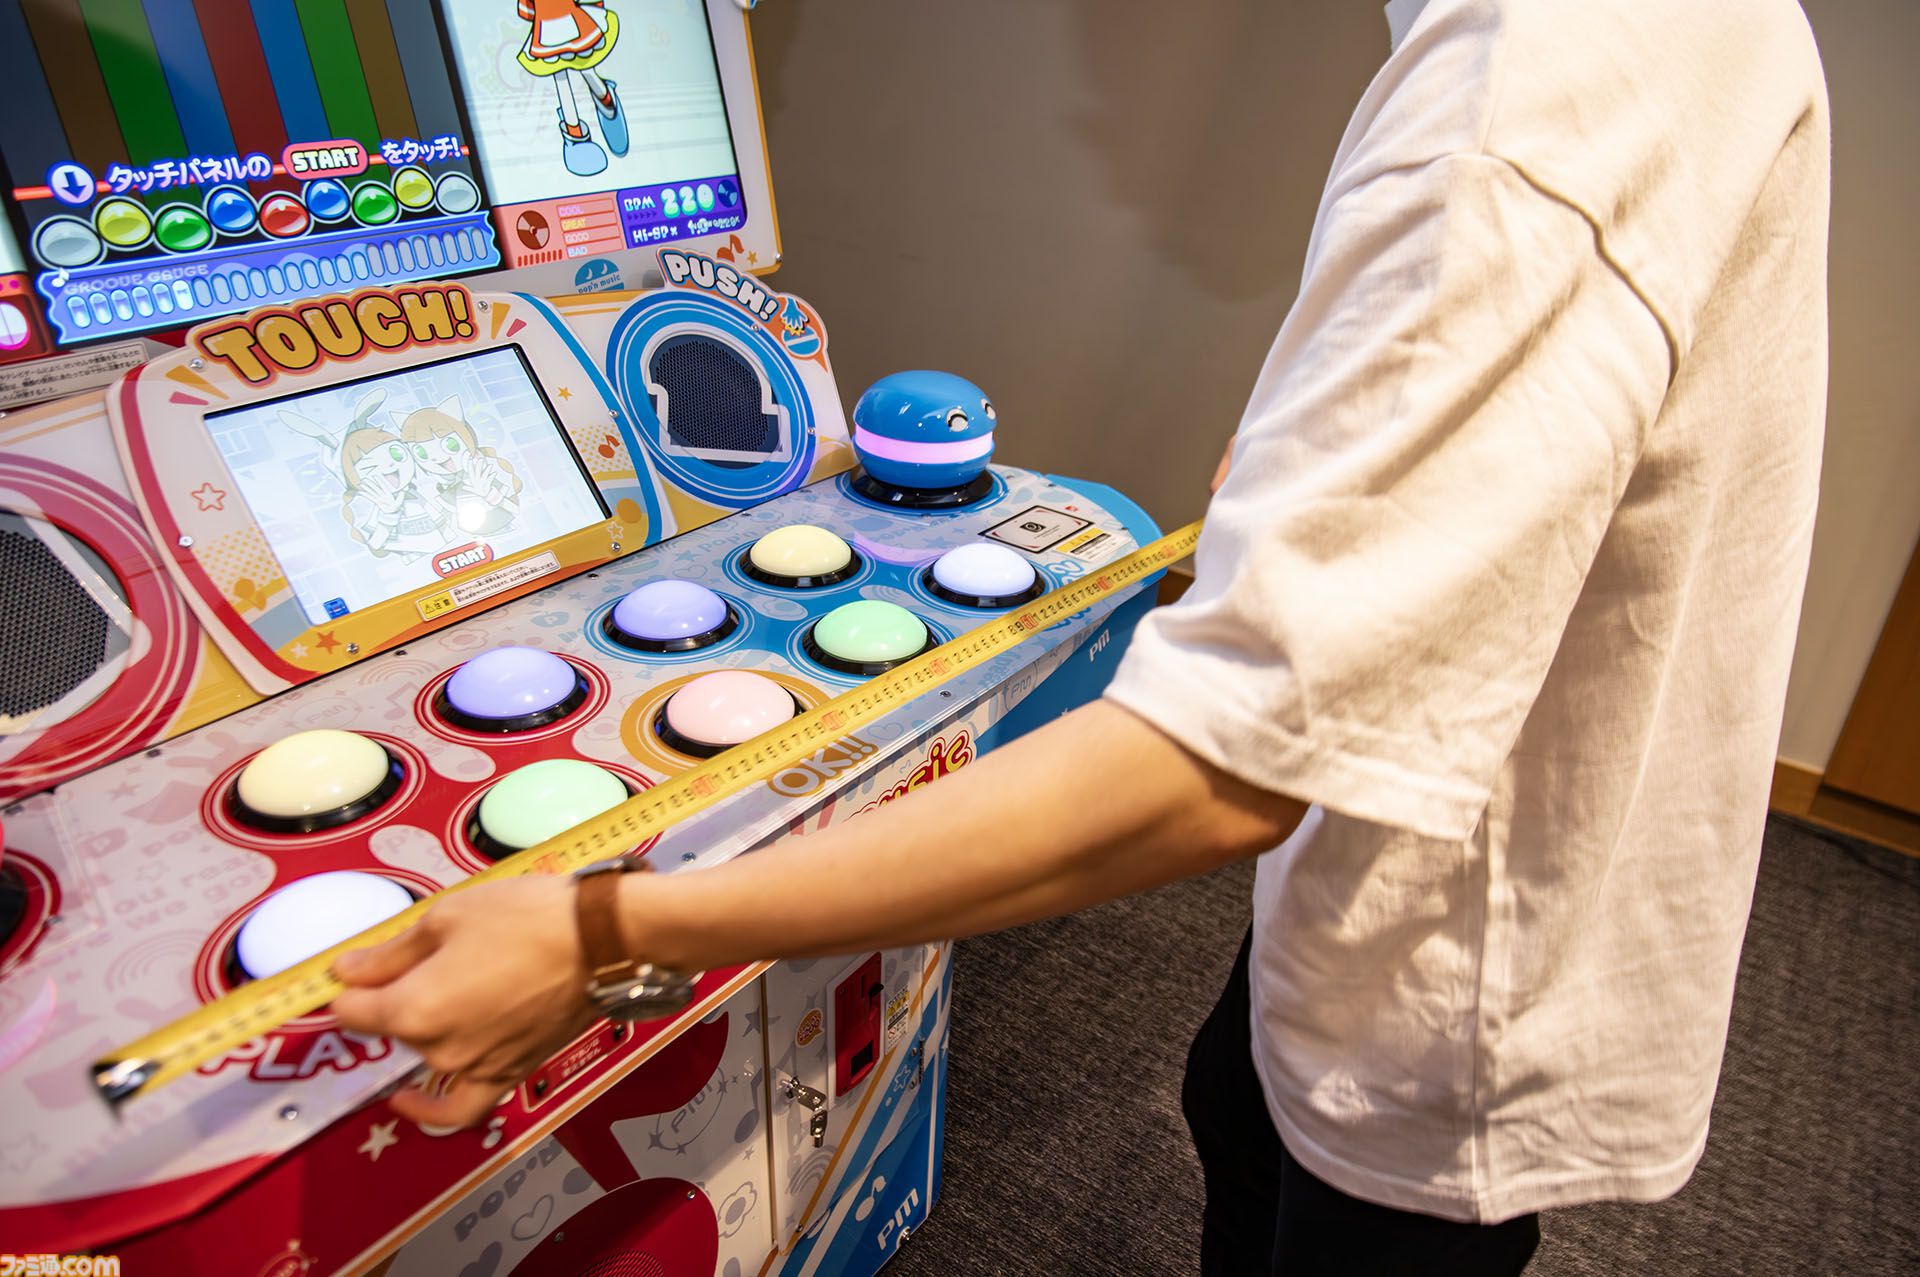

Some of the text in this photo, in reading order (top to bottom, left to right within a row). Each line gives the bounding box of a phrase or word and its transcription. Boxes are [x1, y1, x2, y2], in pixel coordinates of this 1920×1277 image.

[108, 154, 271, 193] タッチパネルの
[291, 147, 360, 173] START
[624, 183, 715, 219] BPM 220
[567, 246, 588, 257] BAD
[147, 264, 210, 283] GAUGE
[664, 253, 779, 320] PUSH!
[202, 285, 473, 383] TOUCH!
[438, 546, 487, 574] START
[773, 736, 873, 795] OK!!
